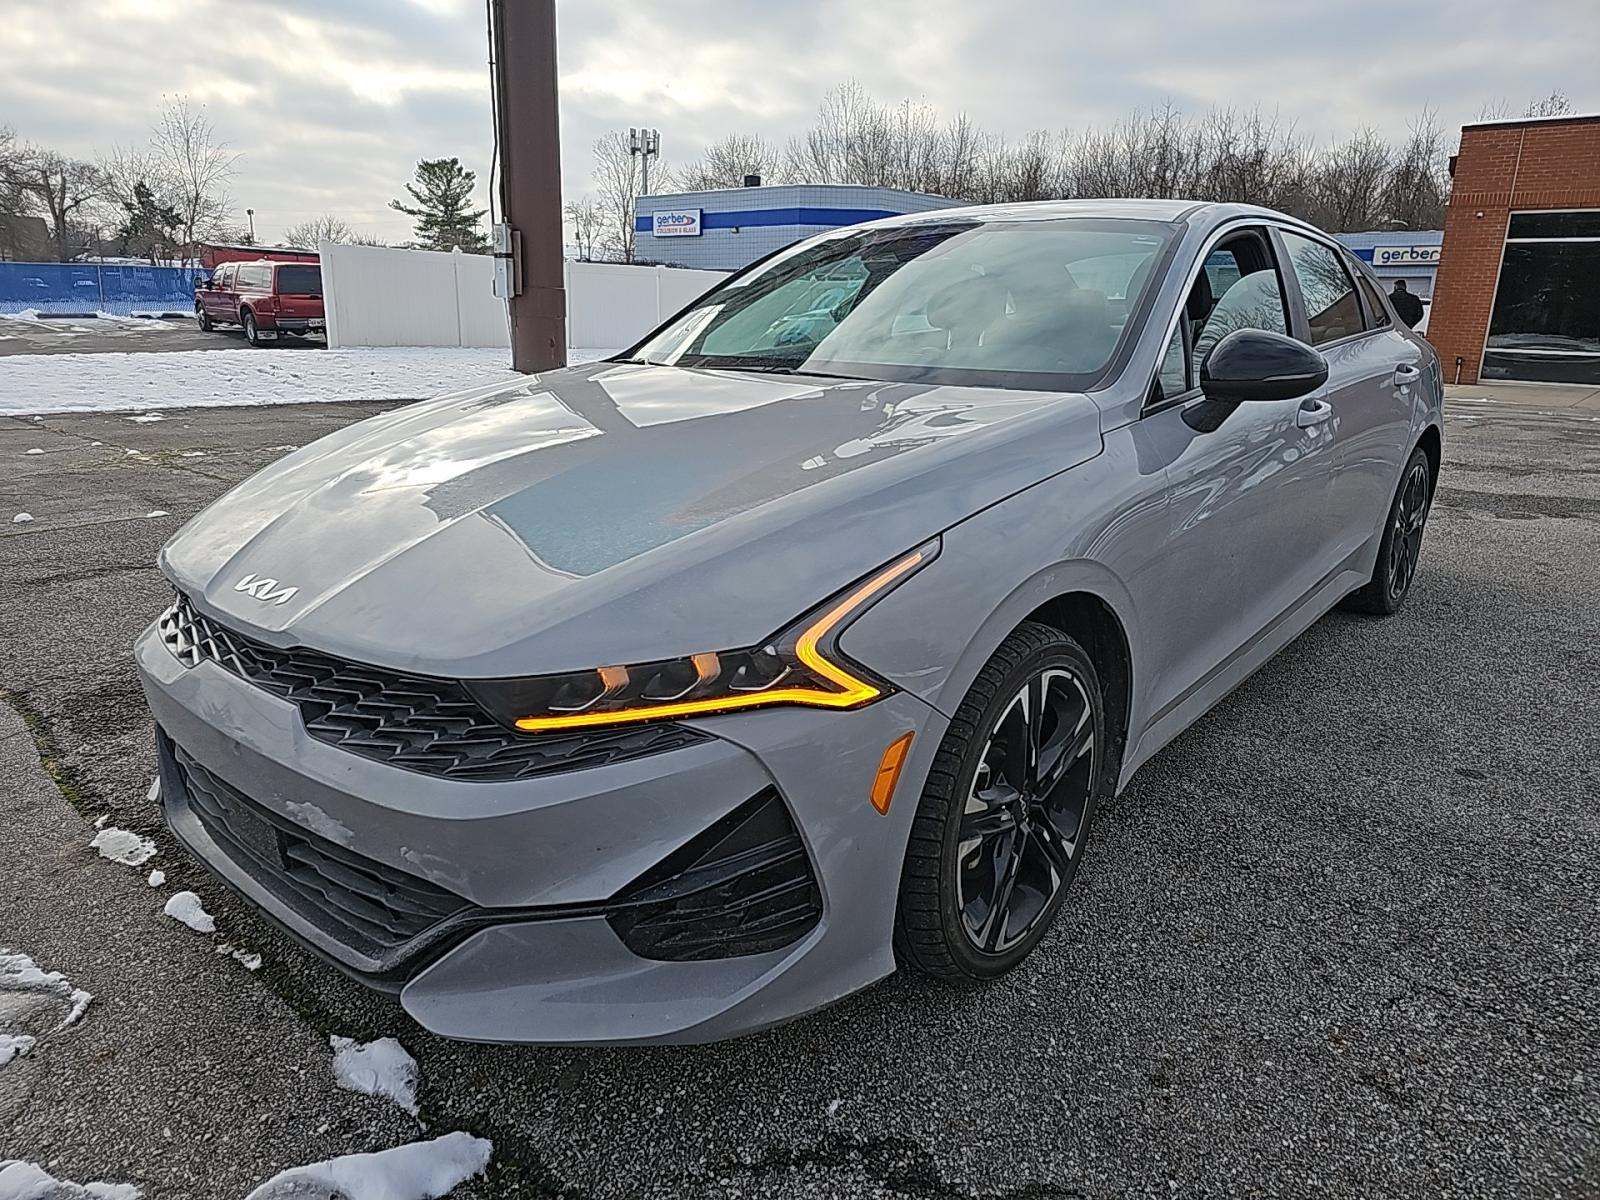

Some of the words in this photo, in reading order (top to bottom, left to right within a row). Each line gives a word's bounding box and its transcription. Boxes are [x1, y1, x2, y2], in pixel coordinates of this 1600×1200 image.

[656, 213, 687, 227] gerber
[1381, 246, 1439, 263] gerber
[233, 573, 300, 606] KIA
